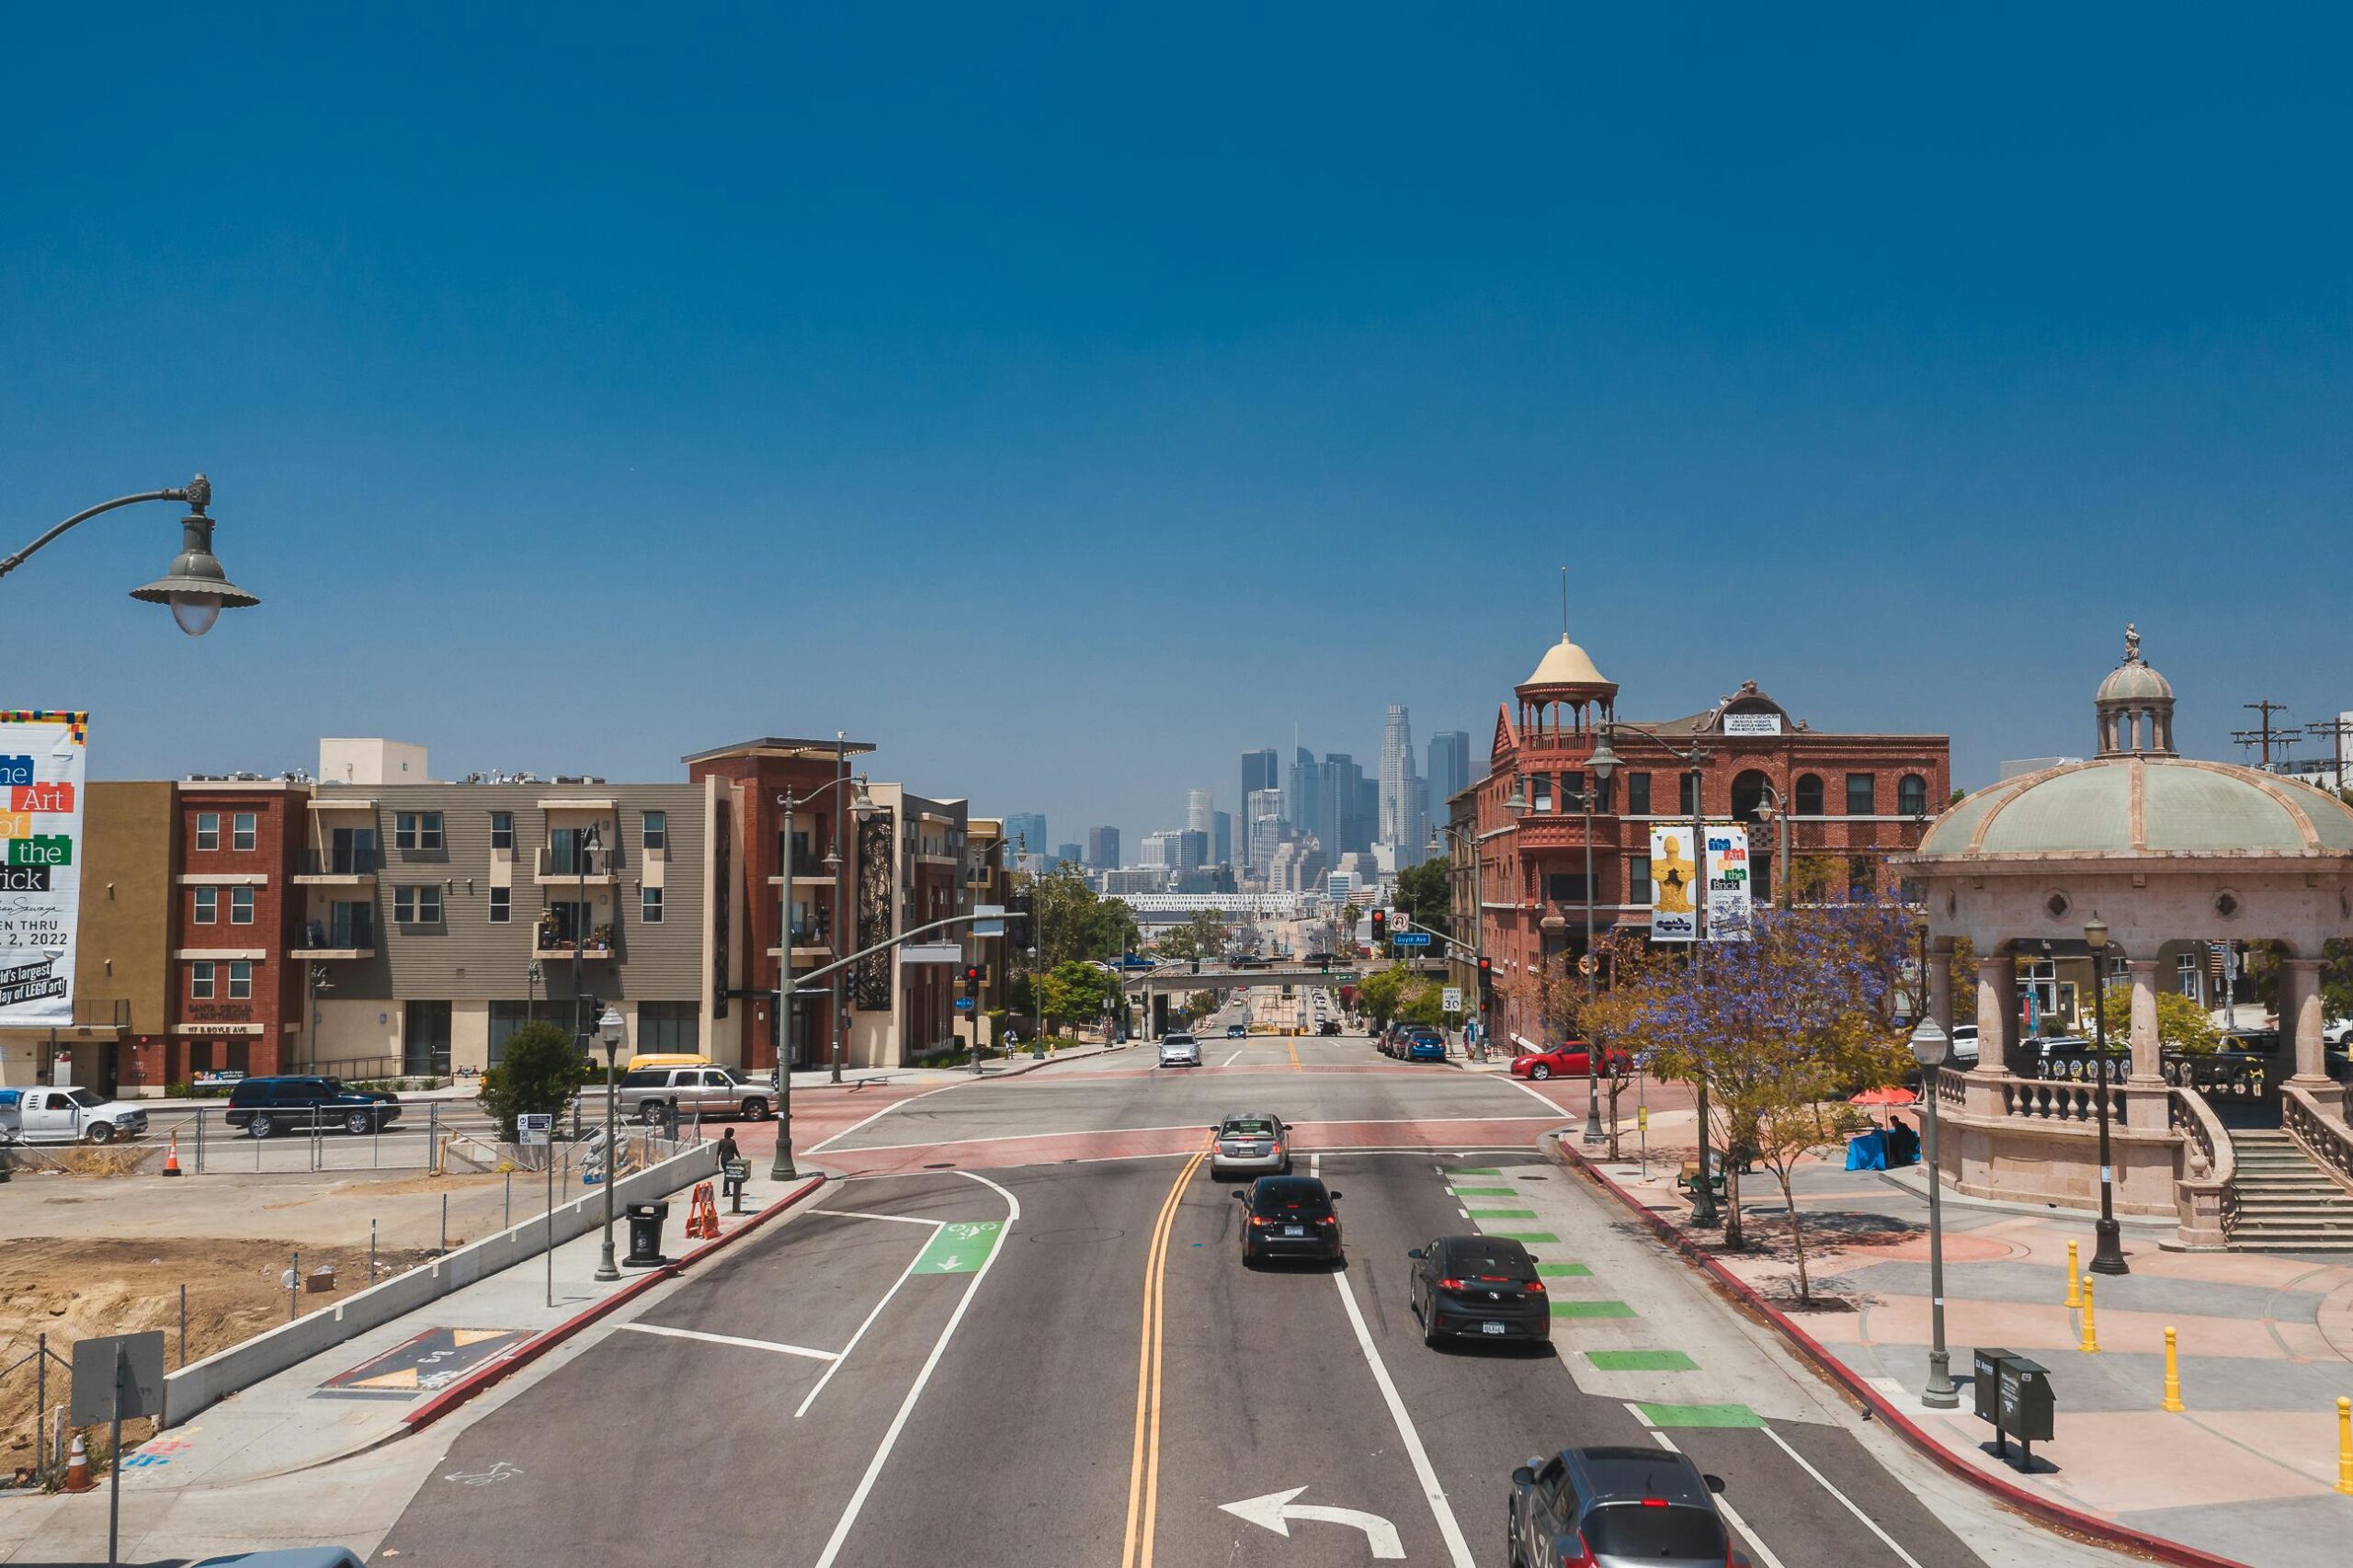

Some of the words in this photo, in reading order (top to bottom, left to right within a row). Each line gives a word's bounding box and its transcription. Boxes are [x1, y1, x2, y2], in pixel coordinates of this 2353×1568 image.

[0, 767, 28, 784] he
[21, 789, 64, 811] Art
[0, 814, 23, 836] of
[18, 841, 63, 863] the
[1710, 841, 1729, 850] The
[1728, 851, 1743, 860] Art
[0, 868, 42, 890] ick
[1728, 871, 1744, 880] the
[1713, 881, 1738, 890] Brick
[20, 920, 58, 930] THRU
[9, 933, 23, 948] 2,
[30, 933, 68, 945] 2022
[0, 970, 17, 983] ld's
[18, 962, 51, 981] largest
[14, 985, 24, 1000] of
[48, 979, 63, 993] art
[188, 1004, 214, 1013] SANTA
[1445, 1000, 1460, 1009] 30
